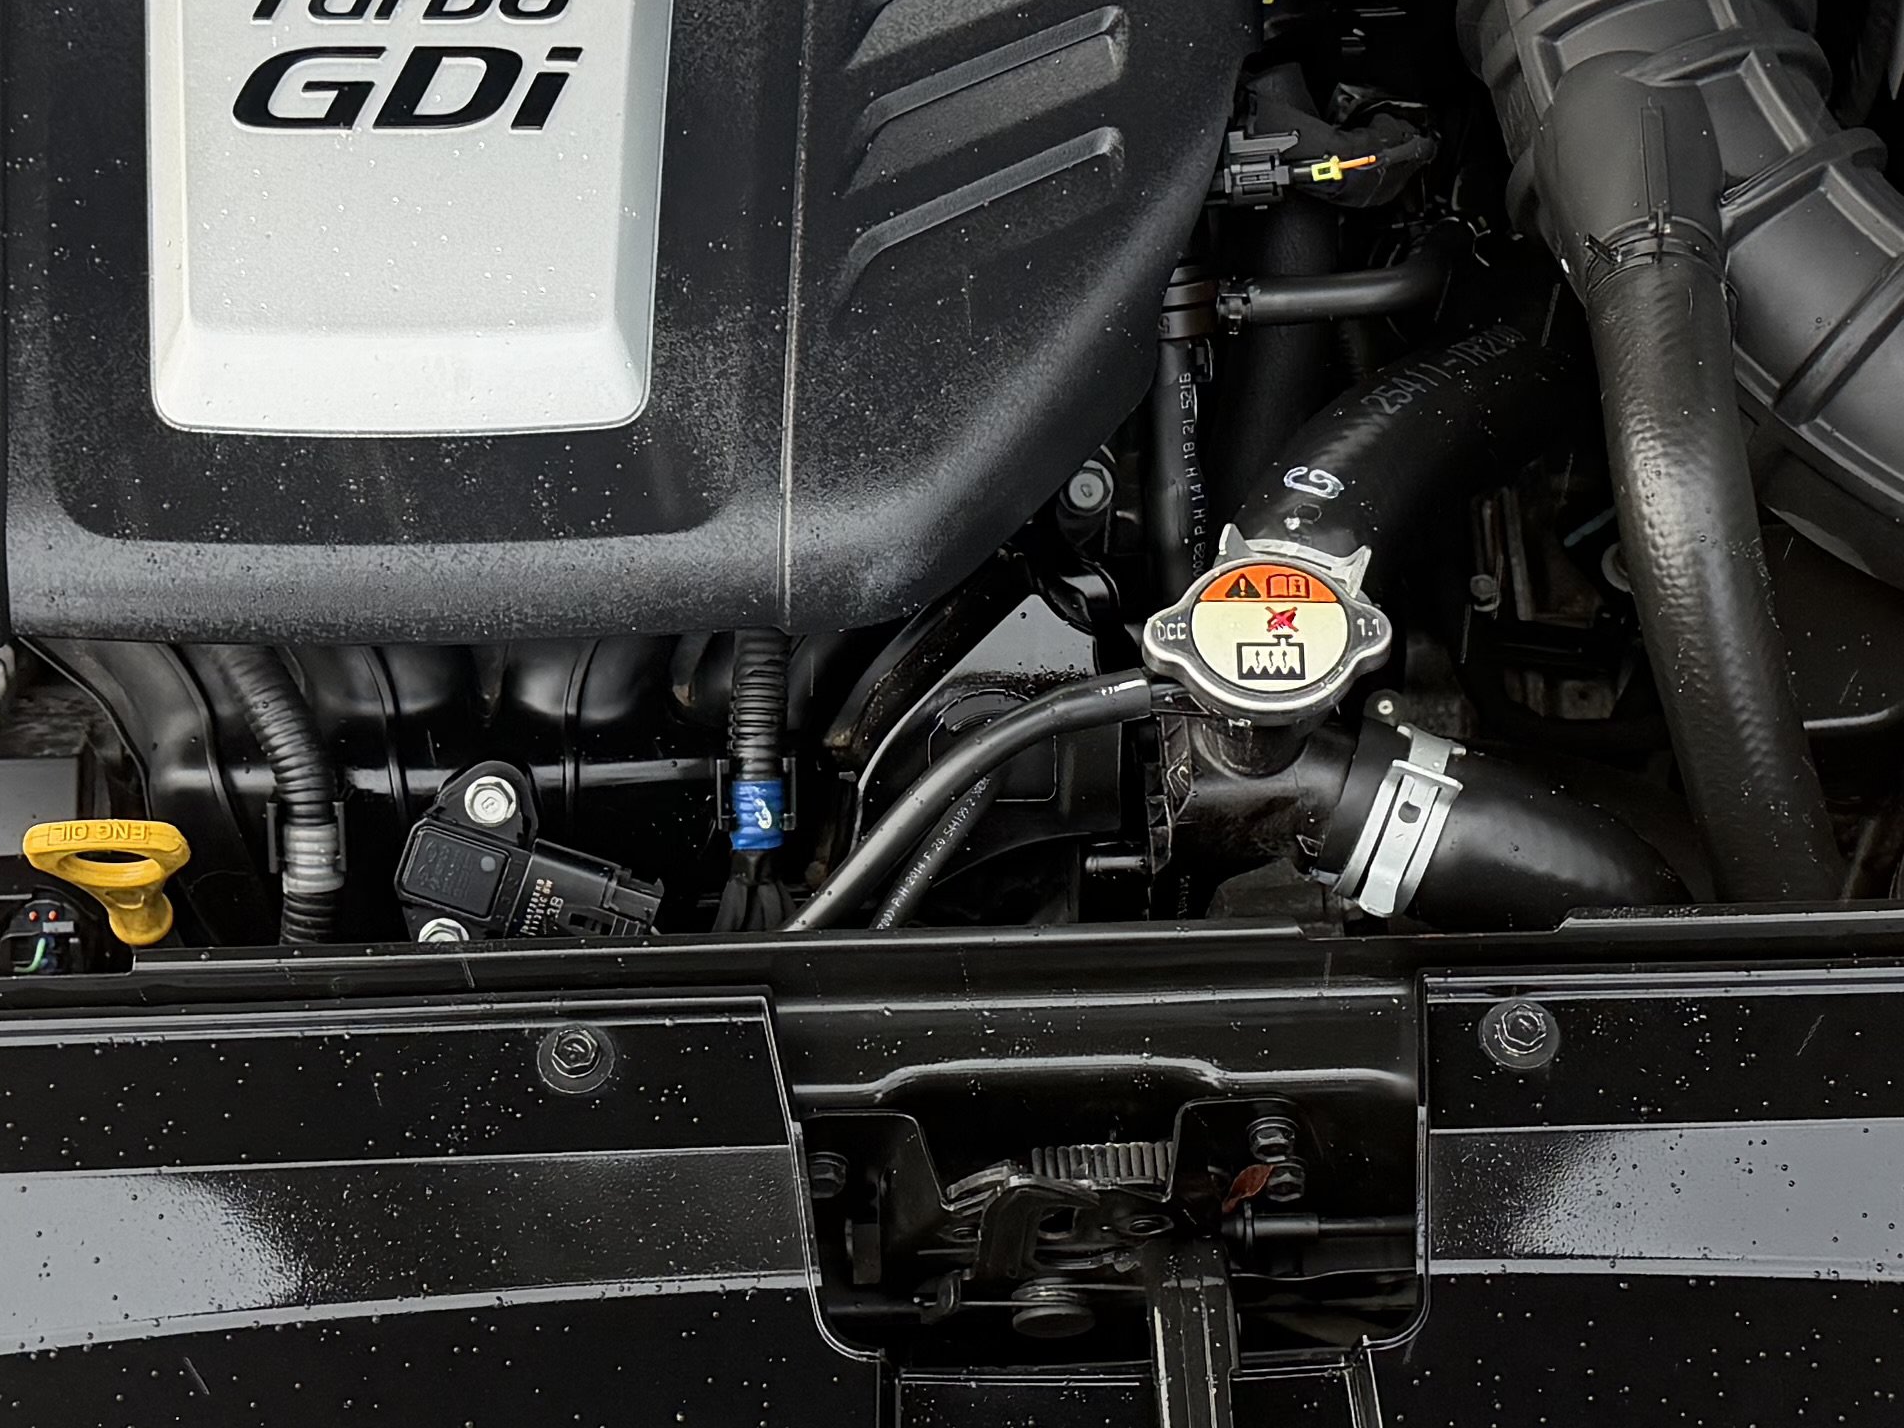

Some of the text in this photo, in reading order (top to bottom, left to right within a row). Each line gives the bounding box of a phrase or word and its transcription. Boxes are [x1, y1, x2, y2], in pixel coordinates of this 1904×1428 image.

[231, 46, 584, 131] GDi
[1357, 618, 1382, 637] 1.1
[52, 823, 146, 841] ENG OIL
